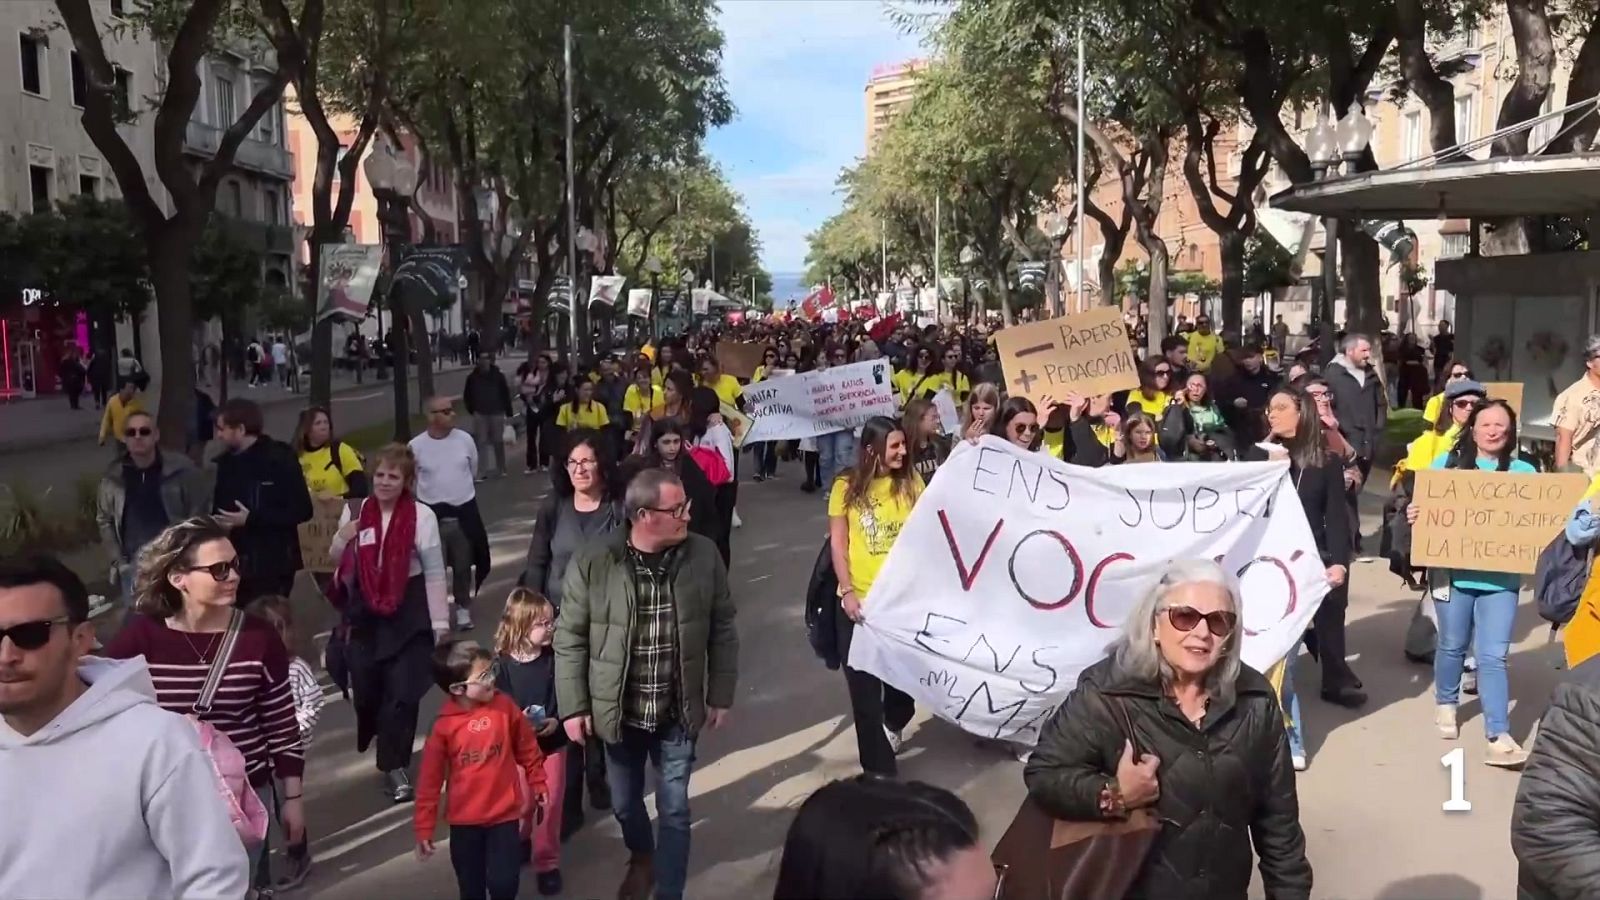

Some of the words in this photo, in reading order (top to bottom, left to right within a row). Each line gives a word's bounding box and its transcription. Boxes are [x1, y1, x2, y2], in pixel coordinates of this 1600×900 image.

[1059, 320, 1122, 349] PAPERS
[748, 388, 778, 407] ALITAT
[753, 403, 793, 418] UCATIVA
[972, 446, 1071, 511] ENS
[1427, 480, 1457, 500] LA
[1426, 509, 1455, 527] NO
[1464, 509, 1495, 526] POT
[1426, 537, 1449, 557] LA
[914, 613, 1056, 693] ENS
